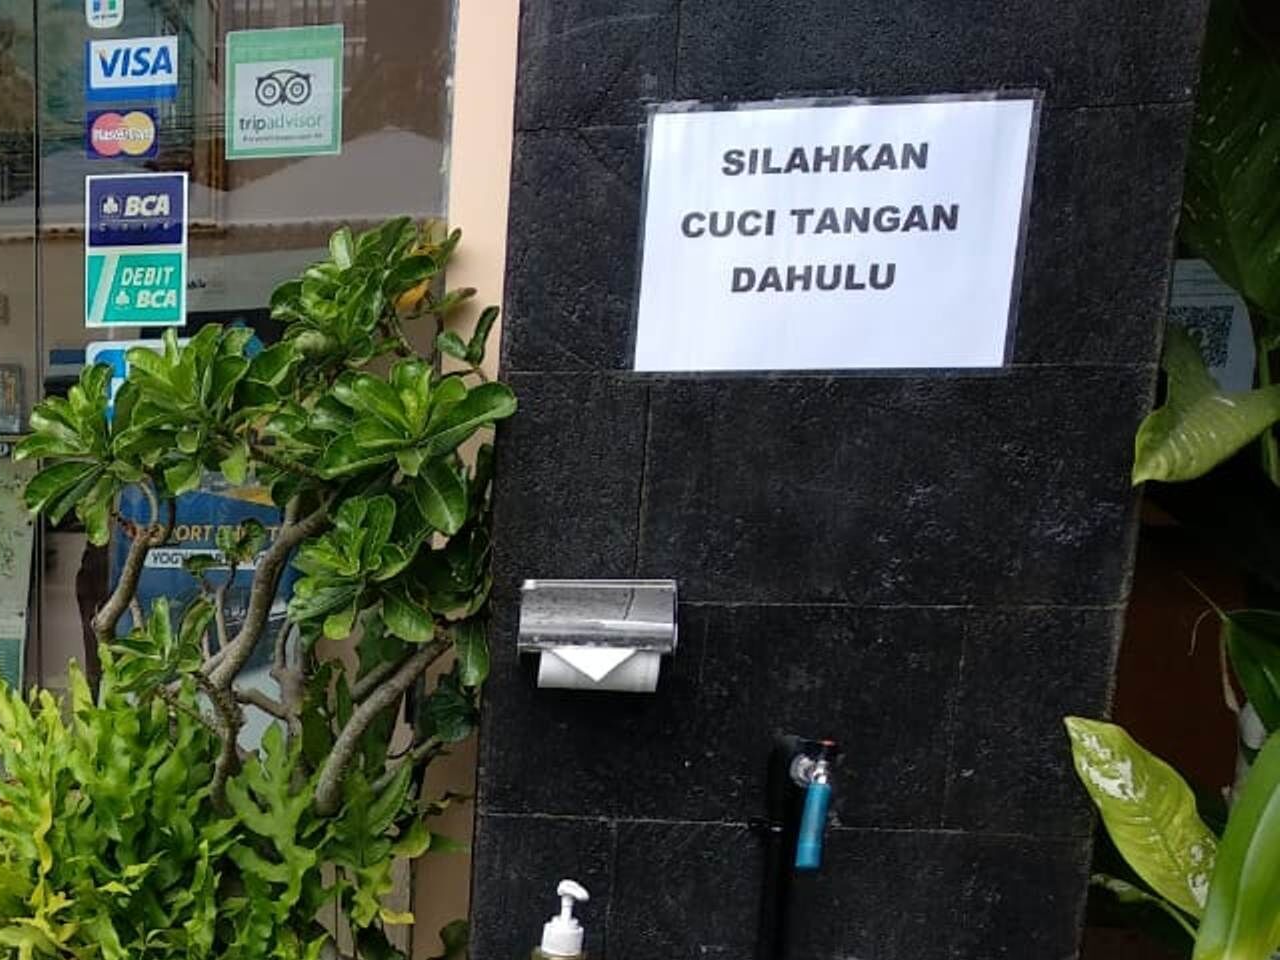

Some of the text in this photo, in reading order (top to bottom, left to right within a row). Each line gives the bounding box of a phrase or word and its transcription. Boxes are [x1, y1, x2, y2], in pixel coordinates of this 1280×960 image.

[99, 46, 173, 77] VISA
[239, 113, 322, 134] tripadvisor
[722, 142, 929, 176] SILAHKAN
[124, 194, 170, 217] BCA
[681, 203, 960, 238] CUCI TANGAN
[121, 266, 174, 286] DEBIT
[731, 263, 896, 293] DAHULU
[136, 289, 177, 308] BCA
